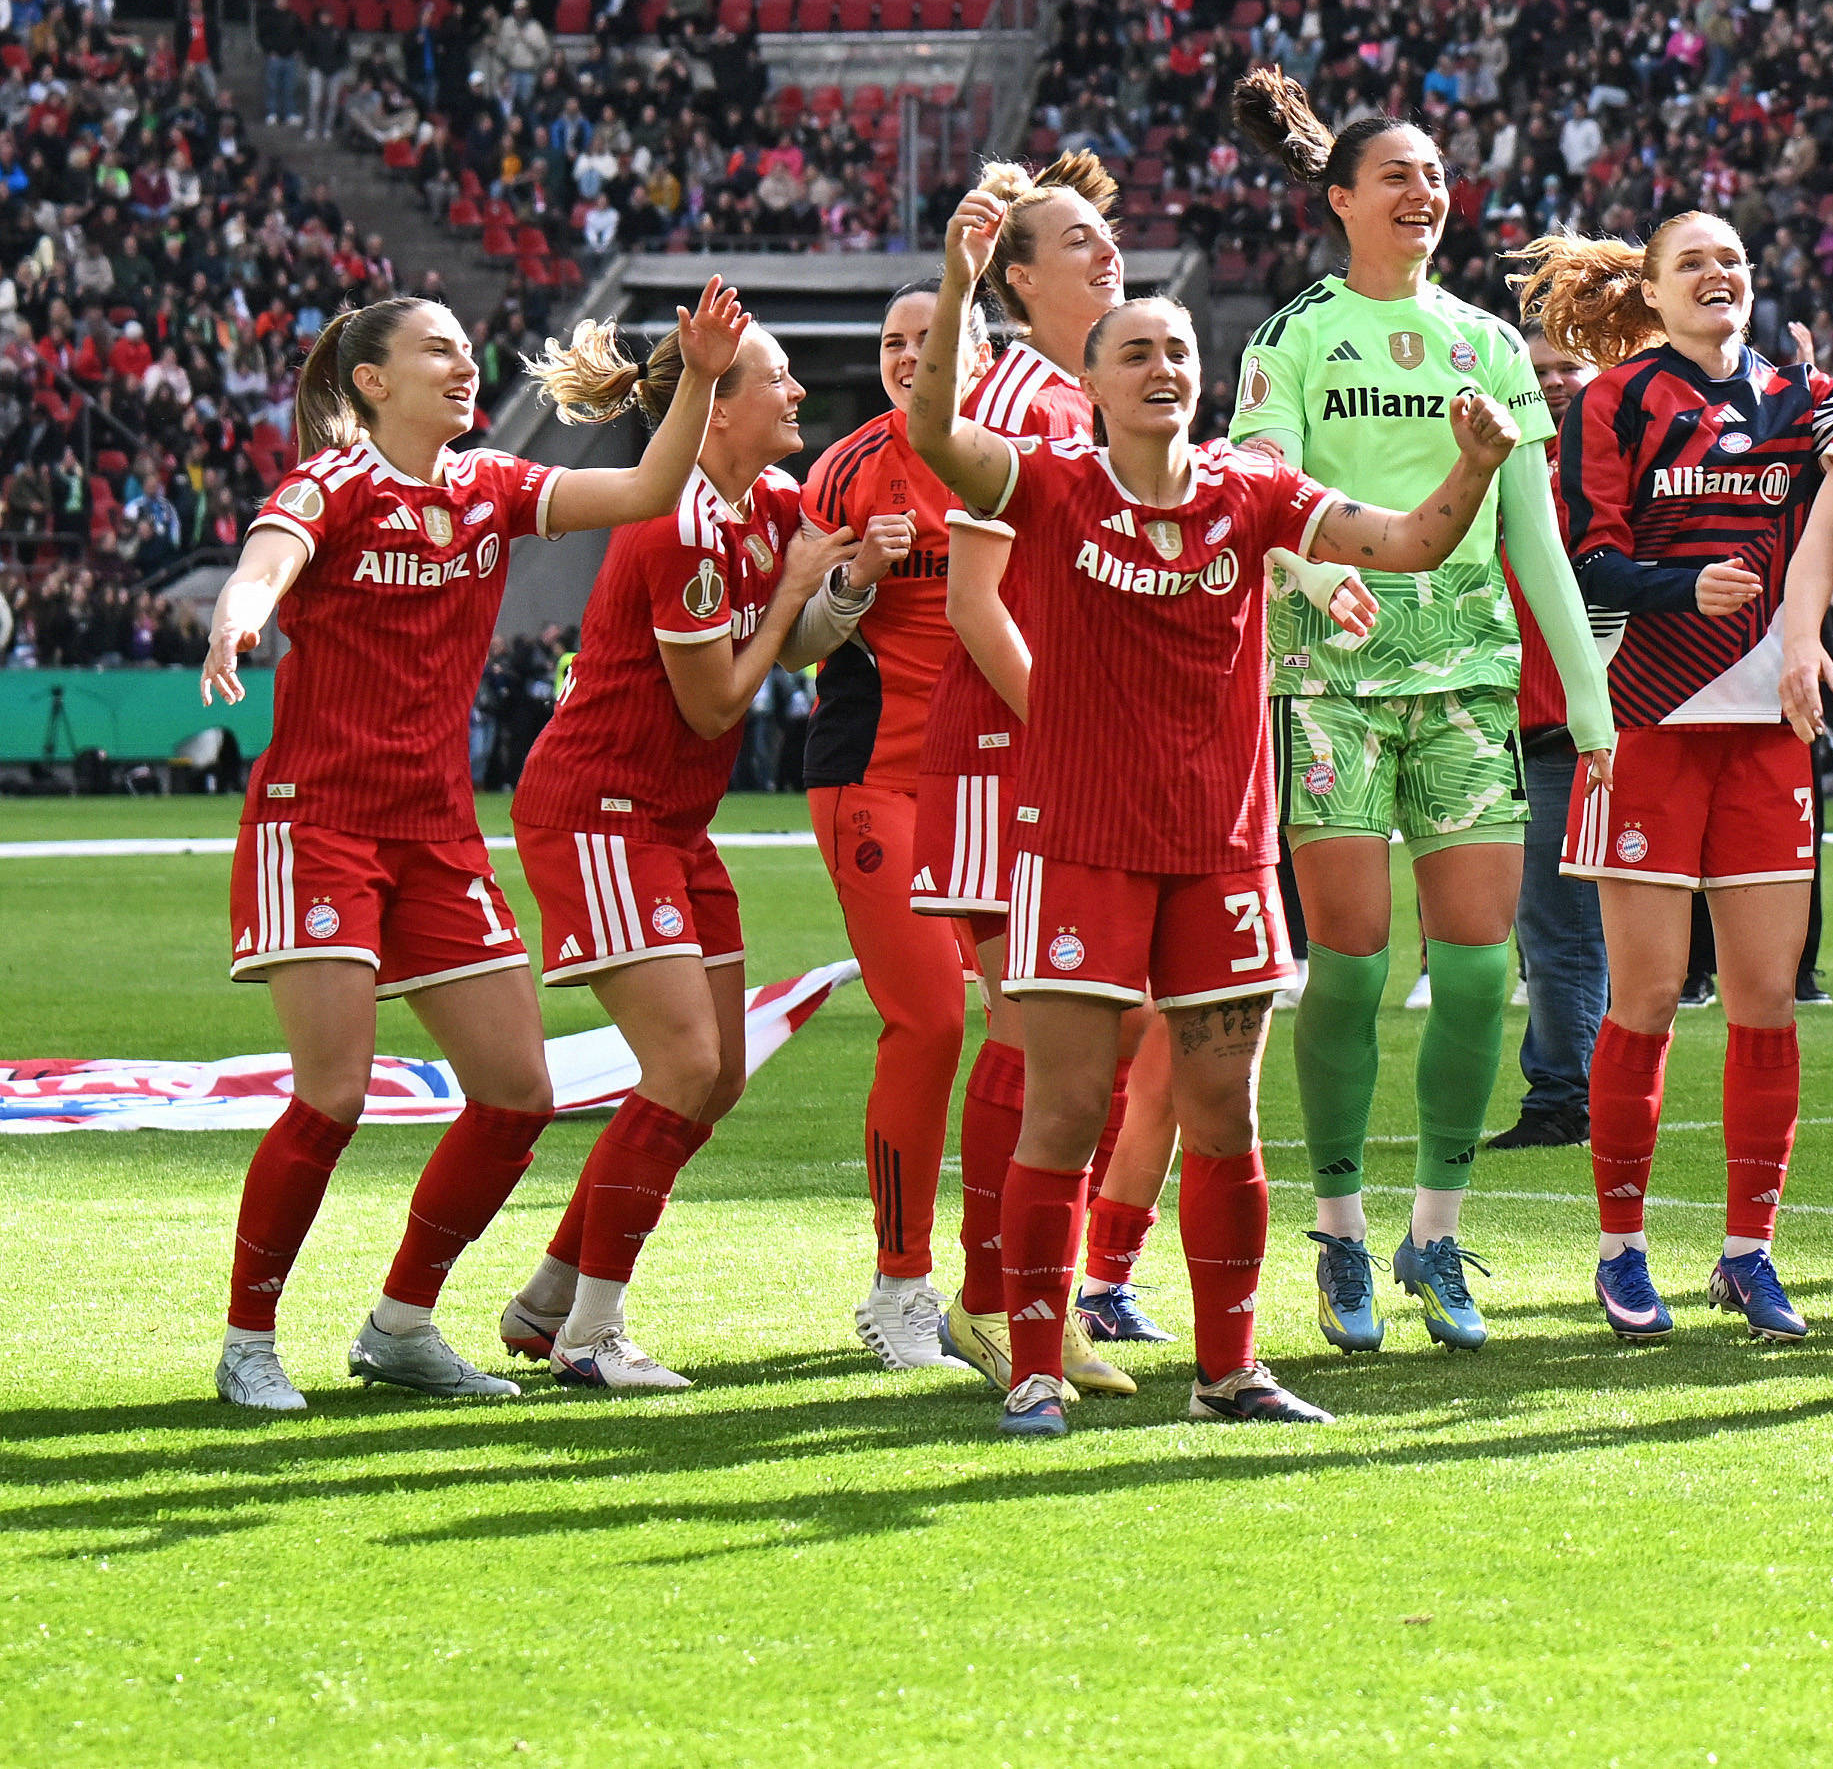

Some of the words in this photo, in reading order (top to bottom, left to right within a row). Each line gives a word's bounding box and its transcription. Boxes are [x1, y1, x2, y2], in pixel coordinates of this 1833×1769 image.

[1323, 387, 1445, 420] Allianz
[1652, 465, 1754, 500] Allianz
[352, 550, 471, 588] Allianz
[1073, 540, 1199, 598] Allianz
[1224, 887, 1298, 973] 31
